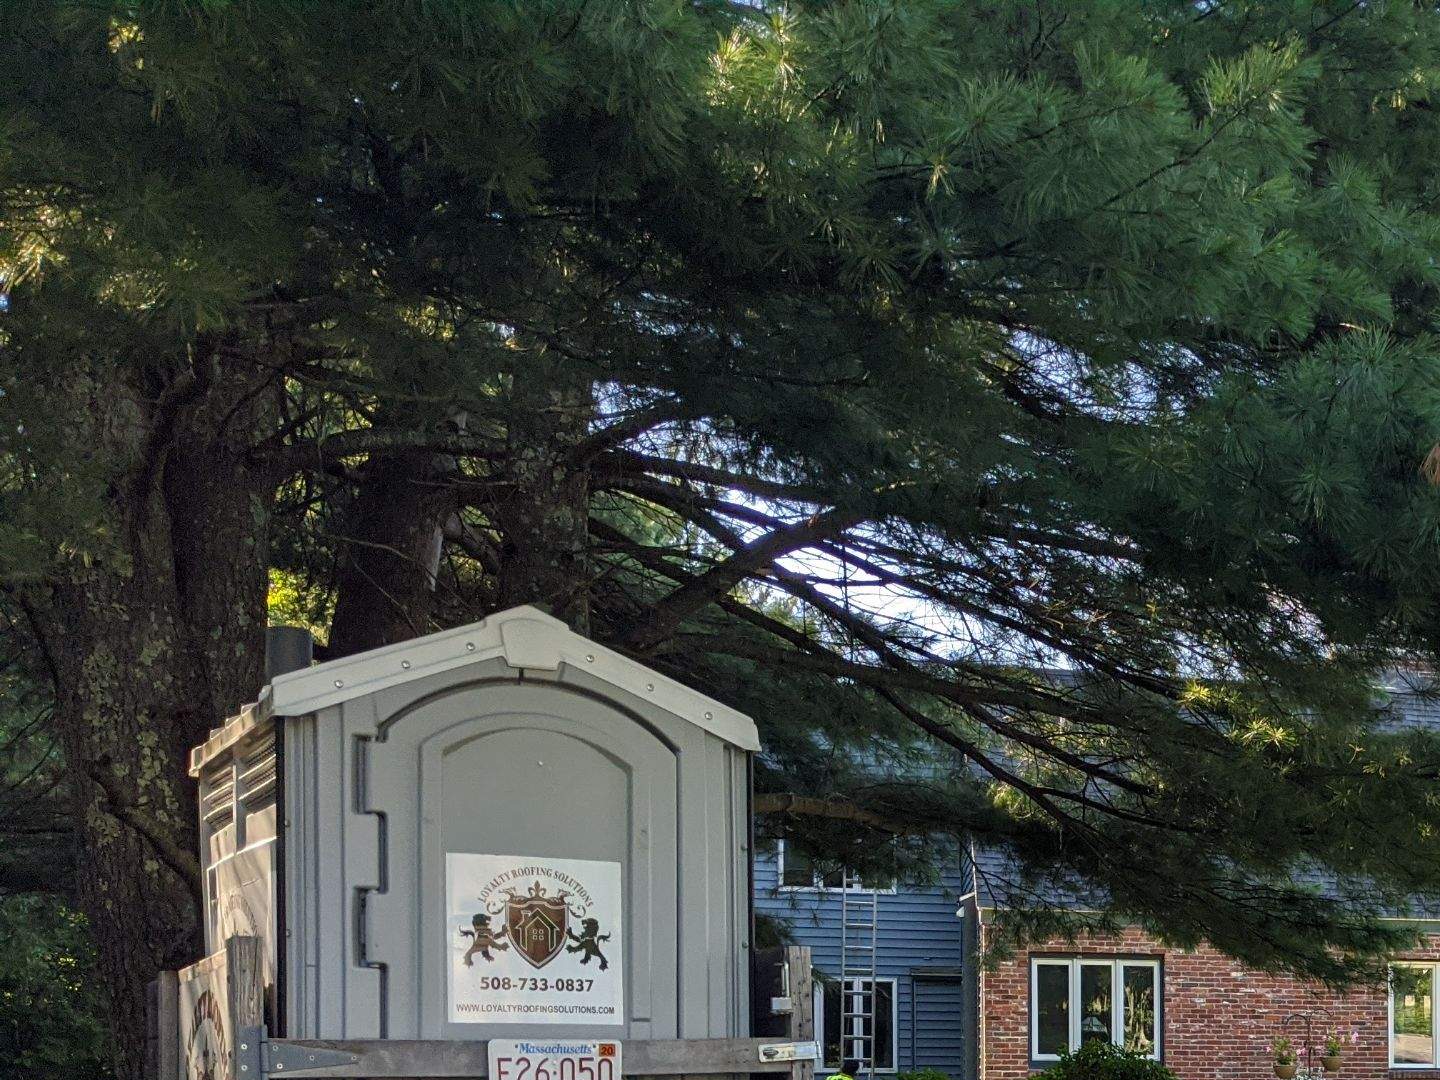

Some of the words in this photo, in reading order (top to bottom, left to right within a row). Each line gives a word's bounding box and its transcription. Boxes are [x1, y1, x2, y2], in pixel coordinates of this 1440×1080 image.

[478, 871, 511, 903] LOYALTY
[511, 866, 553, 878] ROOFING
[553, 870, 594, 908] SOLUTIONS
[480, 976, 594, 992] 508-733-0837
[456, 1003, 615, 1015] WWW.LOYALTYROOFINGSOLUTIONS.COM
[519, 1043, 592, 1054] Massachusetts
[601, 1046, 614, 1056] 20
